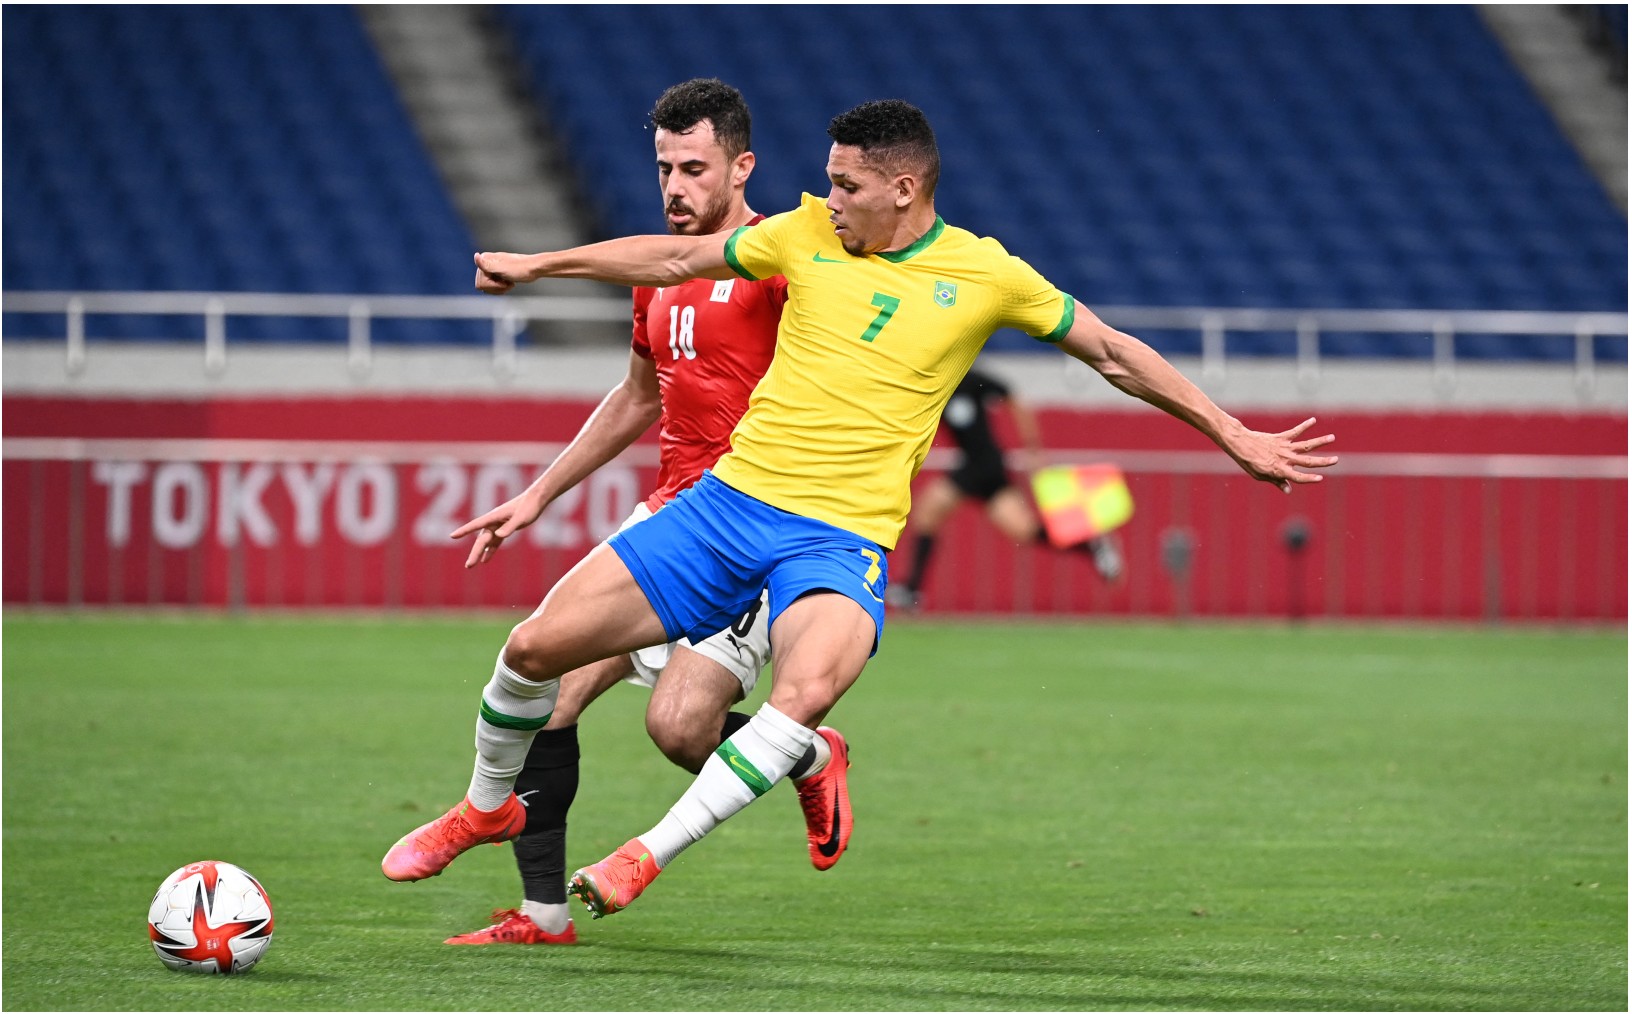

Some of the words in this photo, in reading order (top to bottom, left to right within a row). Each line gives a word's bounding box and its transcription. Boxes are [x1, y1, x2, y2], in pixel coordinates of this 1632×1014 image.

[669, 305, 697, 360] 18
[859, 291, 901, 343] 7
[90, 458, 398, 548] TOKYO
[861, 547, 882, 586] 7
